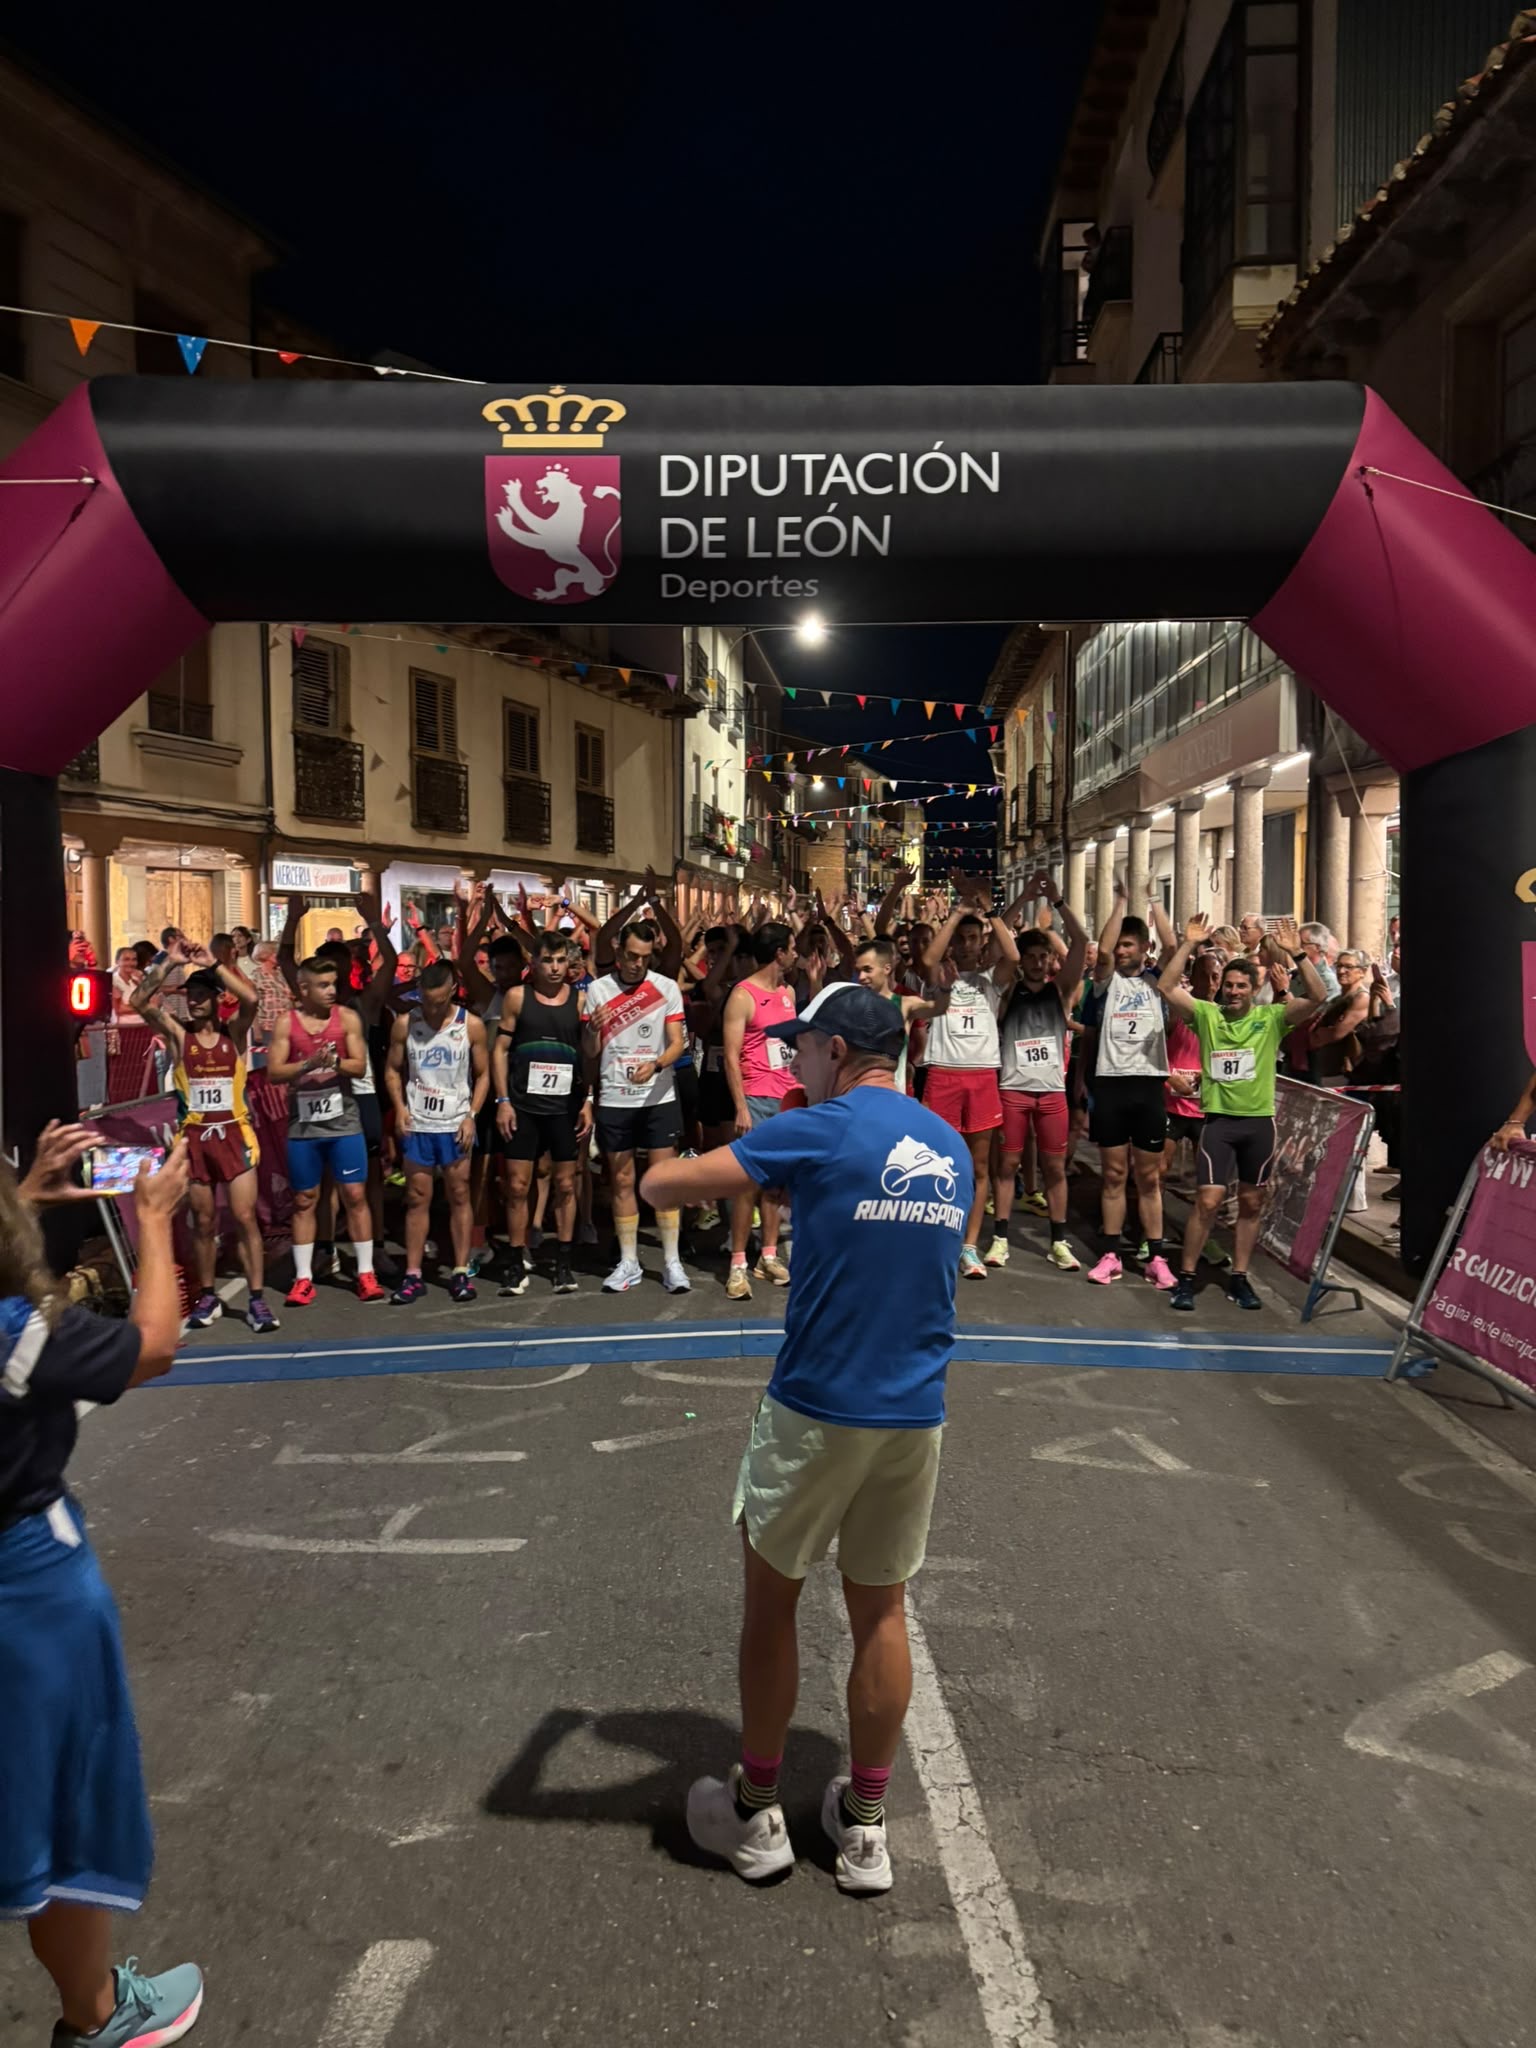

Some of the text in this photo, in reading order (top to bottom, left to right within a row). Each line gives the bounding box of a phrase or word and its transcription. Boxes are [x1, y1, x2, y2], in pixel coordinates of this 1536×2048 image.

[659, 440, 1001, 497] DIPUTACIÓN
[659, 502, 892, 560] DE LEÓN
[660, 573, 820, 602] Deportes
[71, 976, 91, 1011] 0
[961, 1015, 975, 1030] 71
[1128, 1020, 1137, 1035] 2
[1025, 1046, 1049, 1062] 136
[1223, 1060, 1240, 1076] 87
[541, 1073, 559, 1089] 27
[198, 1089, 222, 1105] 113
[423, 1096, 446, 1113] 101
[307, 1099, 333, 1115] 142
